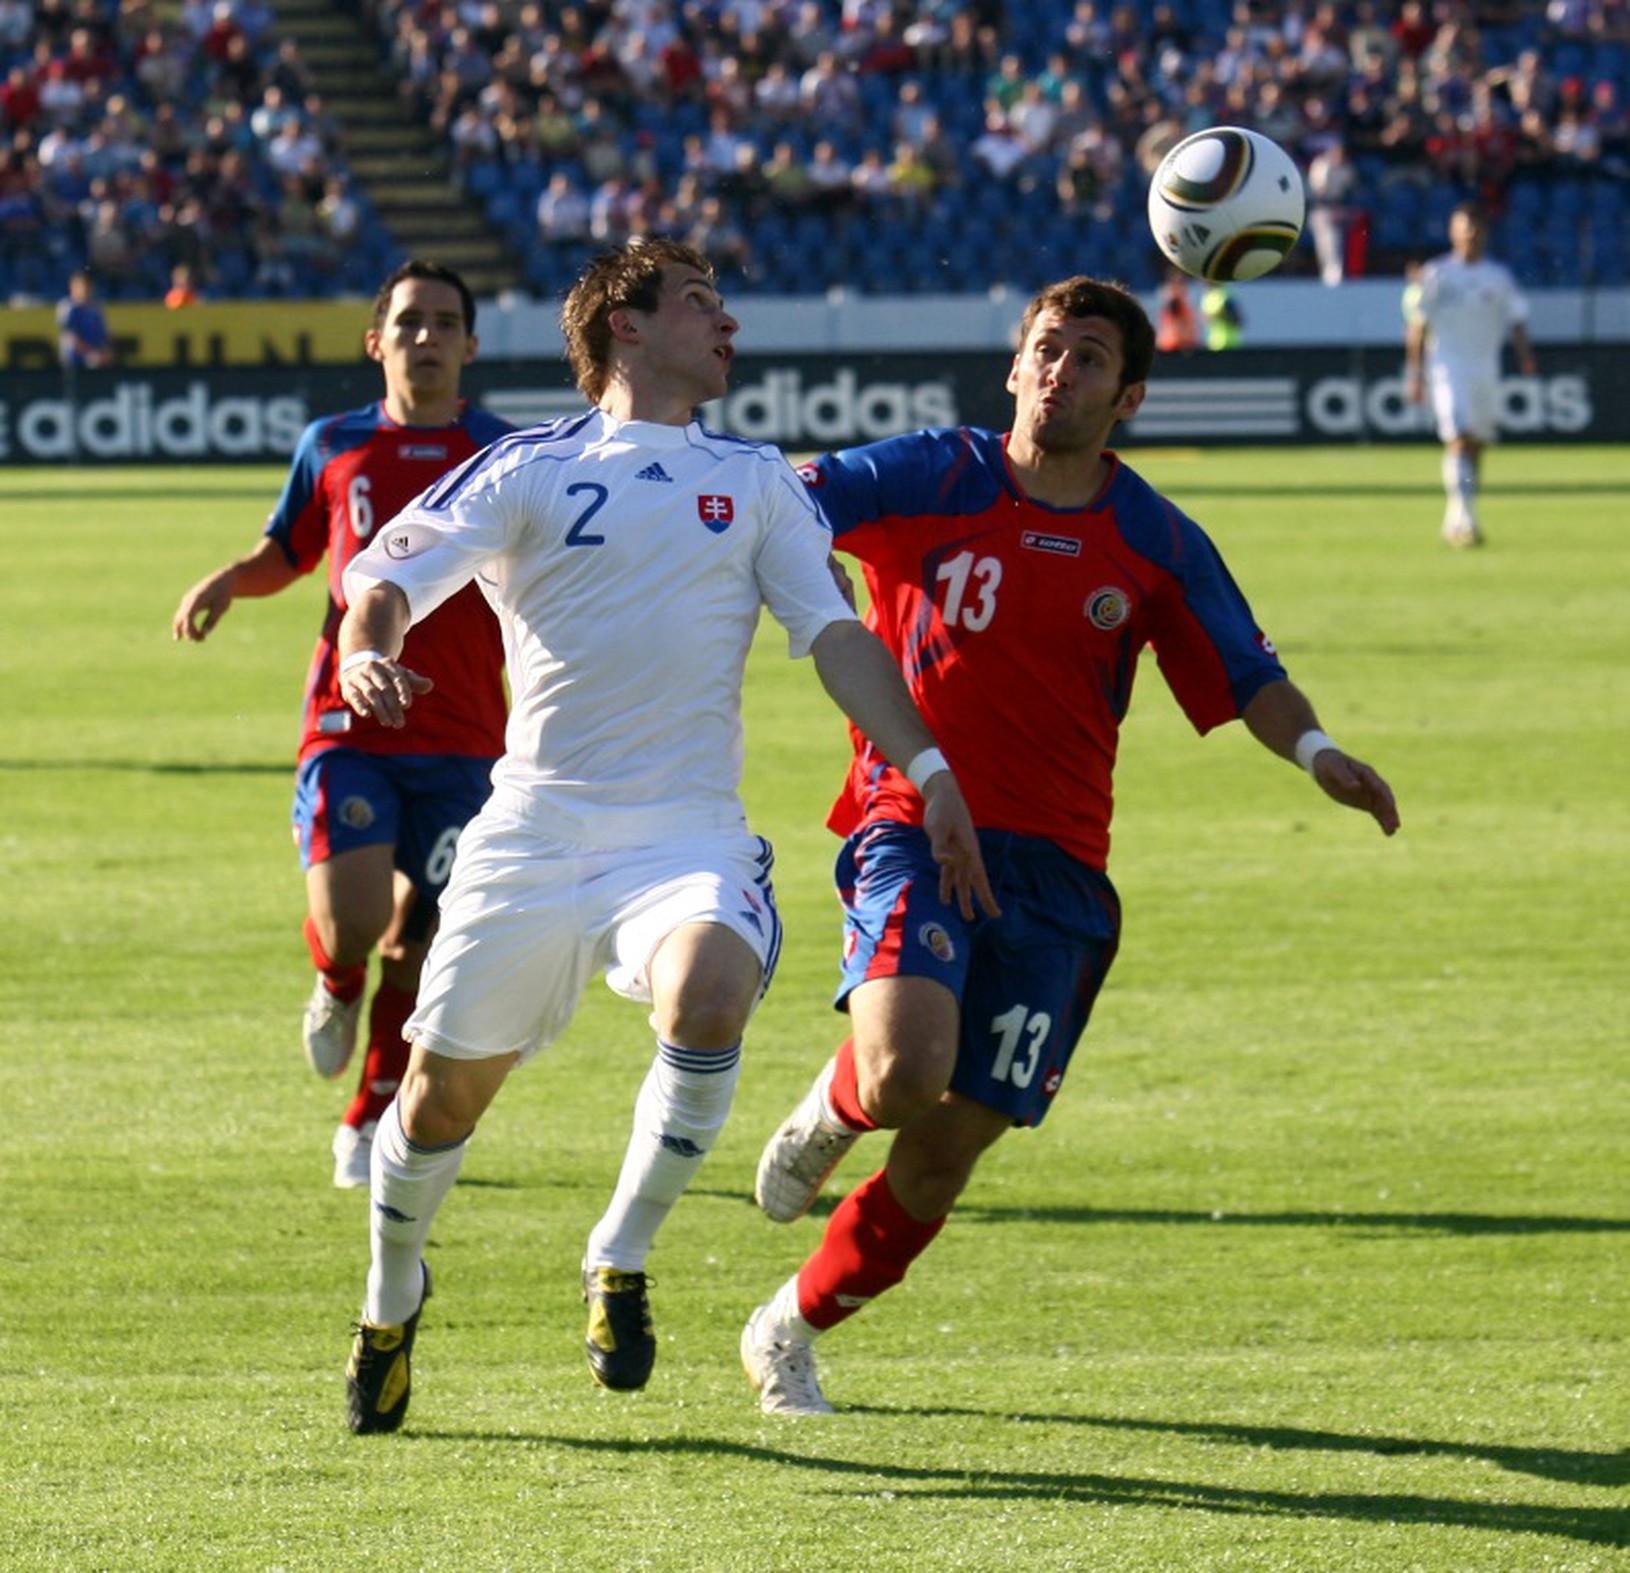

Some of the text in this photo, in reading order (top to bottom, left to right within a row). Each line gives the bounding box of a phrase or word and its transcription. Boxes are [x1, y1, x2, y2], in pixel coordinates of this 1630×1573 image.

[16, 381, 308, 458] adidas
[1307, 374, 1594, 436] adas
[348, 474, 374, 538] 6
[564, 482, 611, 547] 2
[936, 550, 1003, 633] 13
[425, 826, 462, 885] 6
[990, 1004, 1052, 1089] 13
